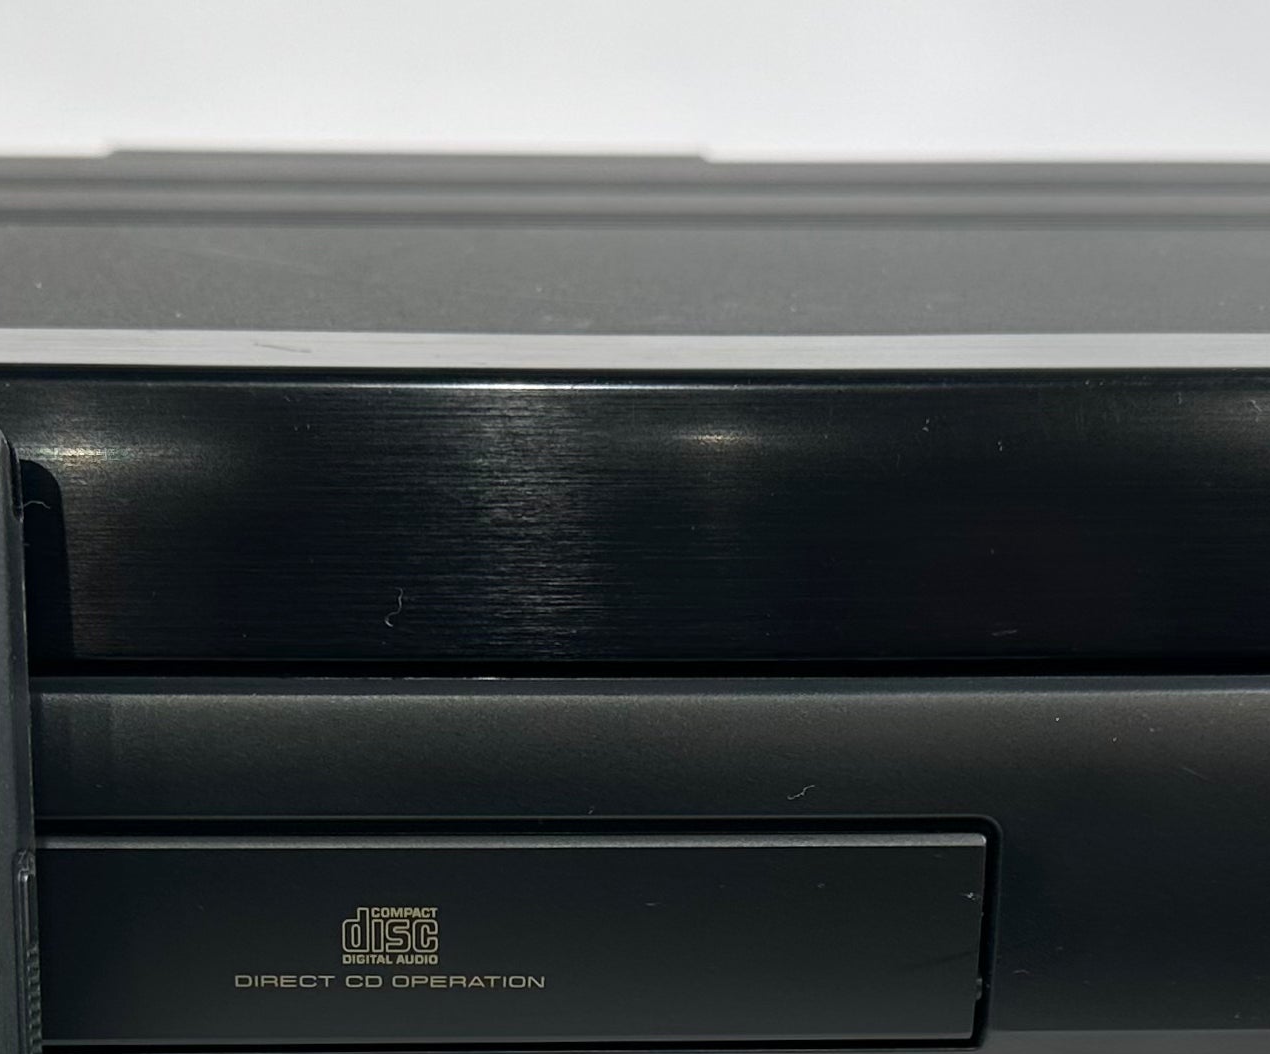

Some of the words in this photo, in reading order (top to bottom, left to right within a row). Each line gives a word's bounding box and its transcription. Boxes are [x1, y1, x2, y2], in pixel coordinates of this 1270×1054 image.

[370, 907, 438, 919] COMPACT
[342, 954, 393, 965] DIGITAL
[396, 954, 439, 965] AUDIO
[234, 975, 336, 989] DIRECT
[344, 975, 383, 989] CD
[391, 975, 546, 989] OPERATION
